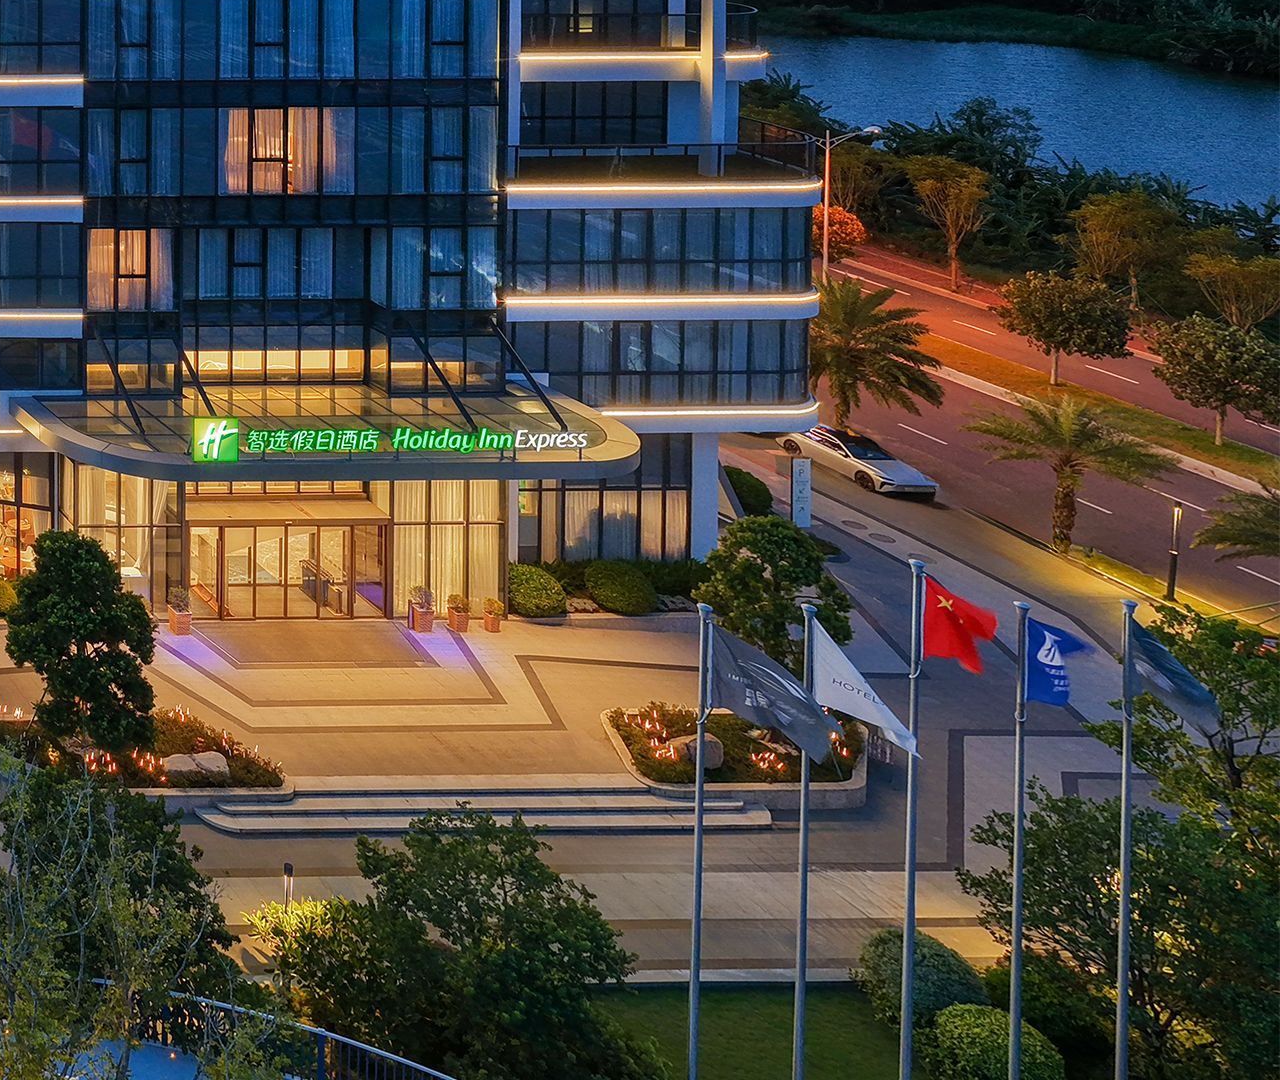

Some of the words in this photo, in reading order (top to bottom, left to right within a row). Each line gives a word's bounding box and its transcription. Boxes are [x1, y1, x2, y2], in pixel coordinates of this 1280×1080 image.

[247, 429, 380, 452] 智选假日酒店
[392, 428, 475, 454] Holiday
[478, 427, 514, 450] Inn
[515, 429, 587, 452] Express
